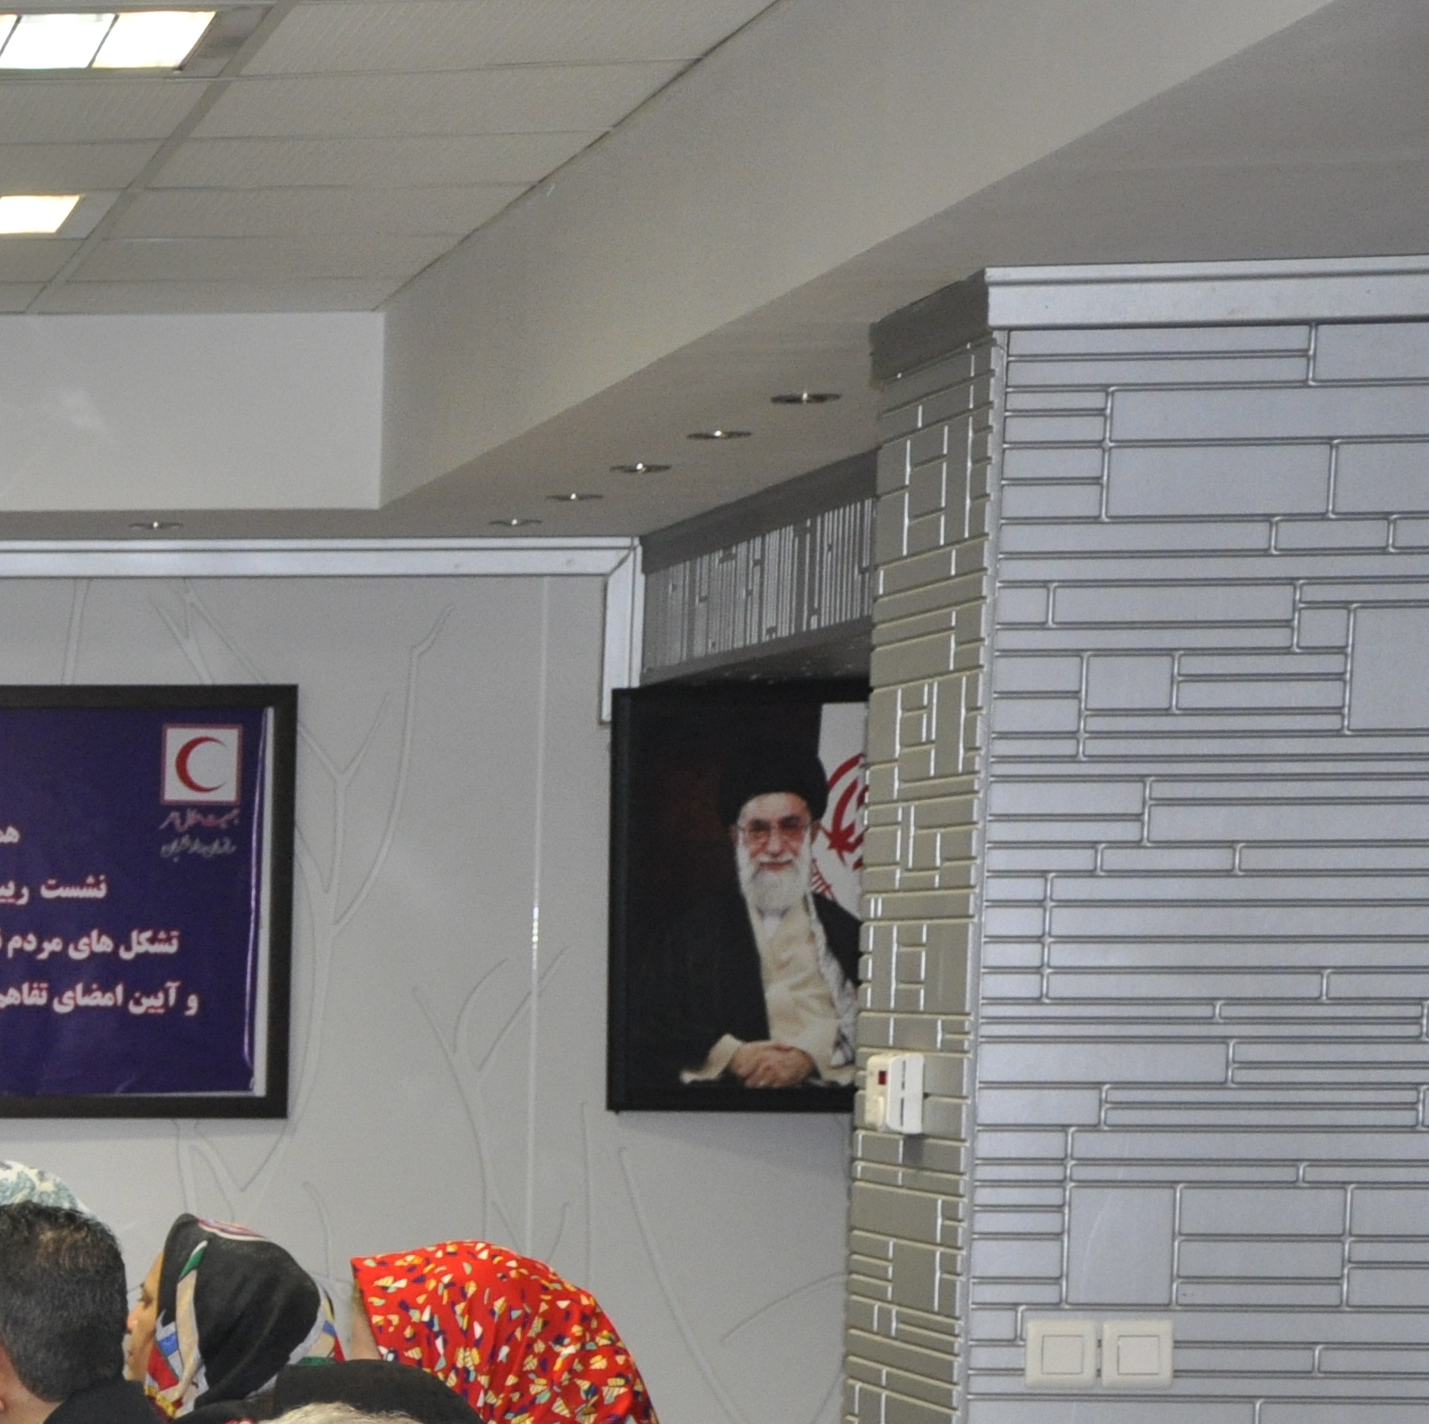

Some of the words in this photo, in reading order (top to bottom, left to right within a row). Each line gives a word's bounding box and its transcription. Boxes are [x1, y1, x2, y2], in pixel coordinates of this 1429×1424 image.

[39, 875, 109, 899] نشست
[6, 931, 64, 960] مردم
[67, 929, 114, 960] های
[118, 929, 181, 960] تشکل
[52, 982, 125, 1014] امضای
[184, 991, 199, 1016] و
